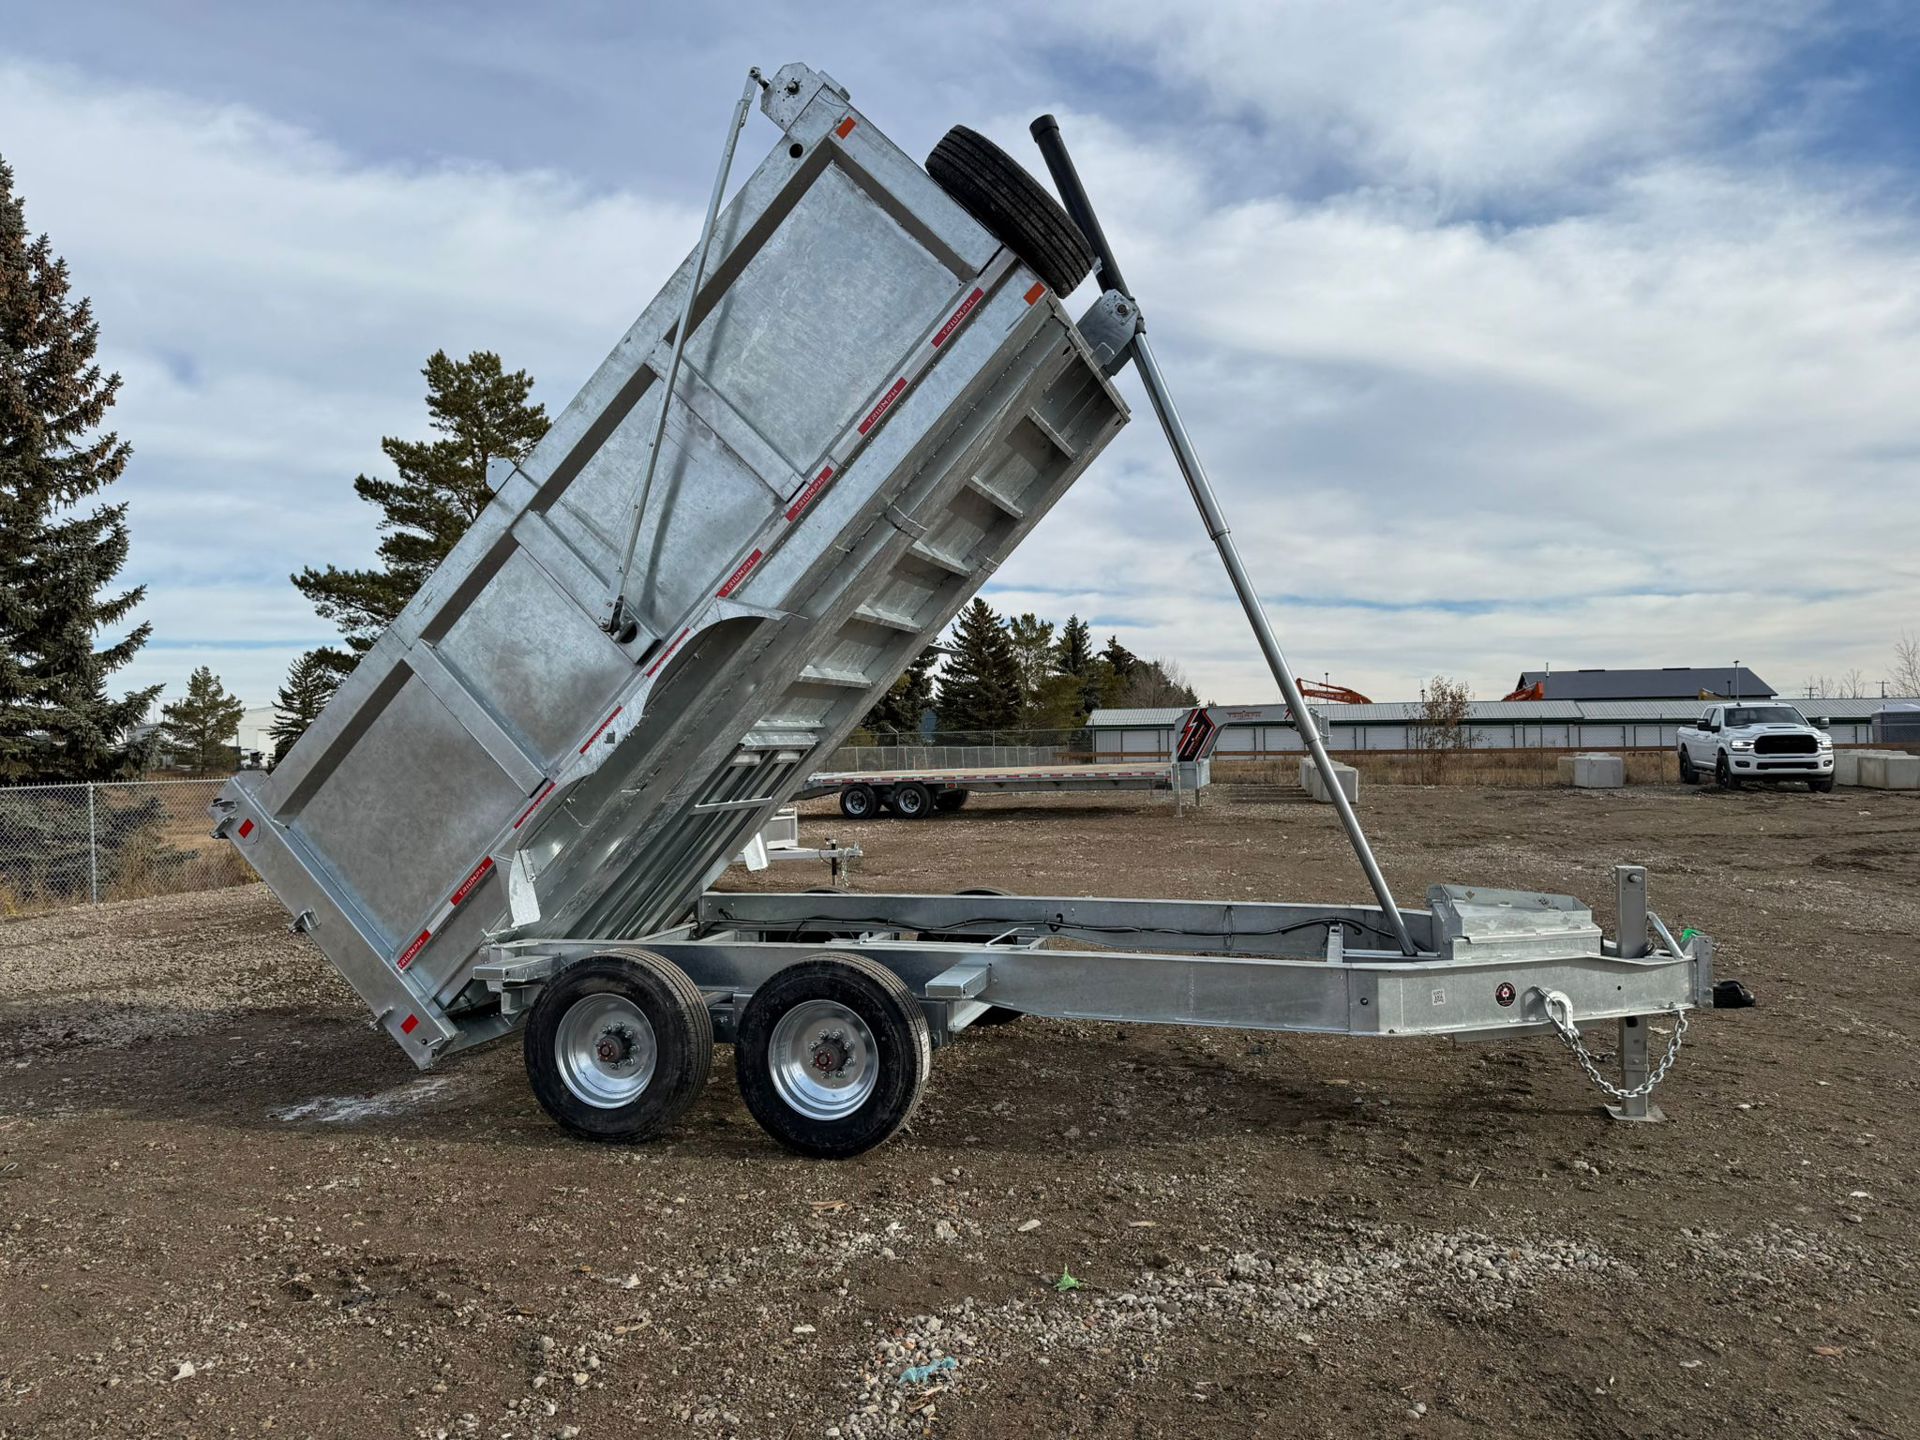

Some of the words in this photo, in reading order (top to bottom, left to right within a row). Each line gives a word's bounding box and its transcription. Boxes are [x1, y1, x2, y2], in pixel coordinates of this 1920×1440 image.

[941, 299, 974, 336] TRIUMPH
[868, 389, 898, 424] TRIUMPH
[793, 477, 824, 511] TRIUMPH
[724, 559, 754, 592] TRIUMPH
[458, 866, 486, 896] TRIUMPH
[398, 938, 424, 968] TRIUMPH
